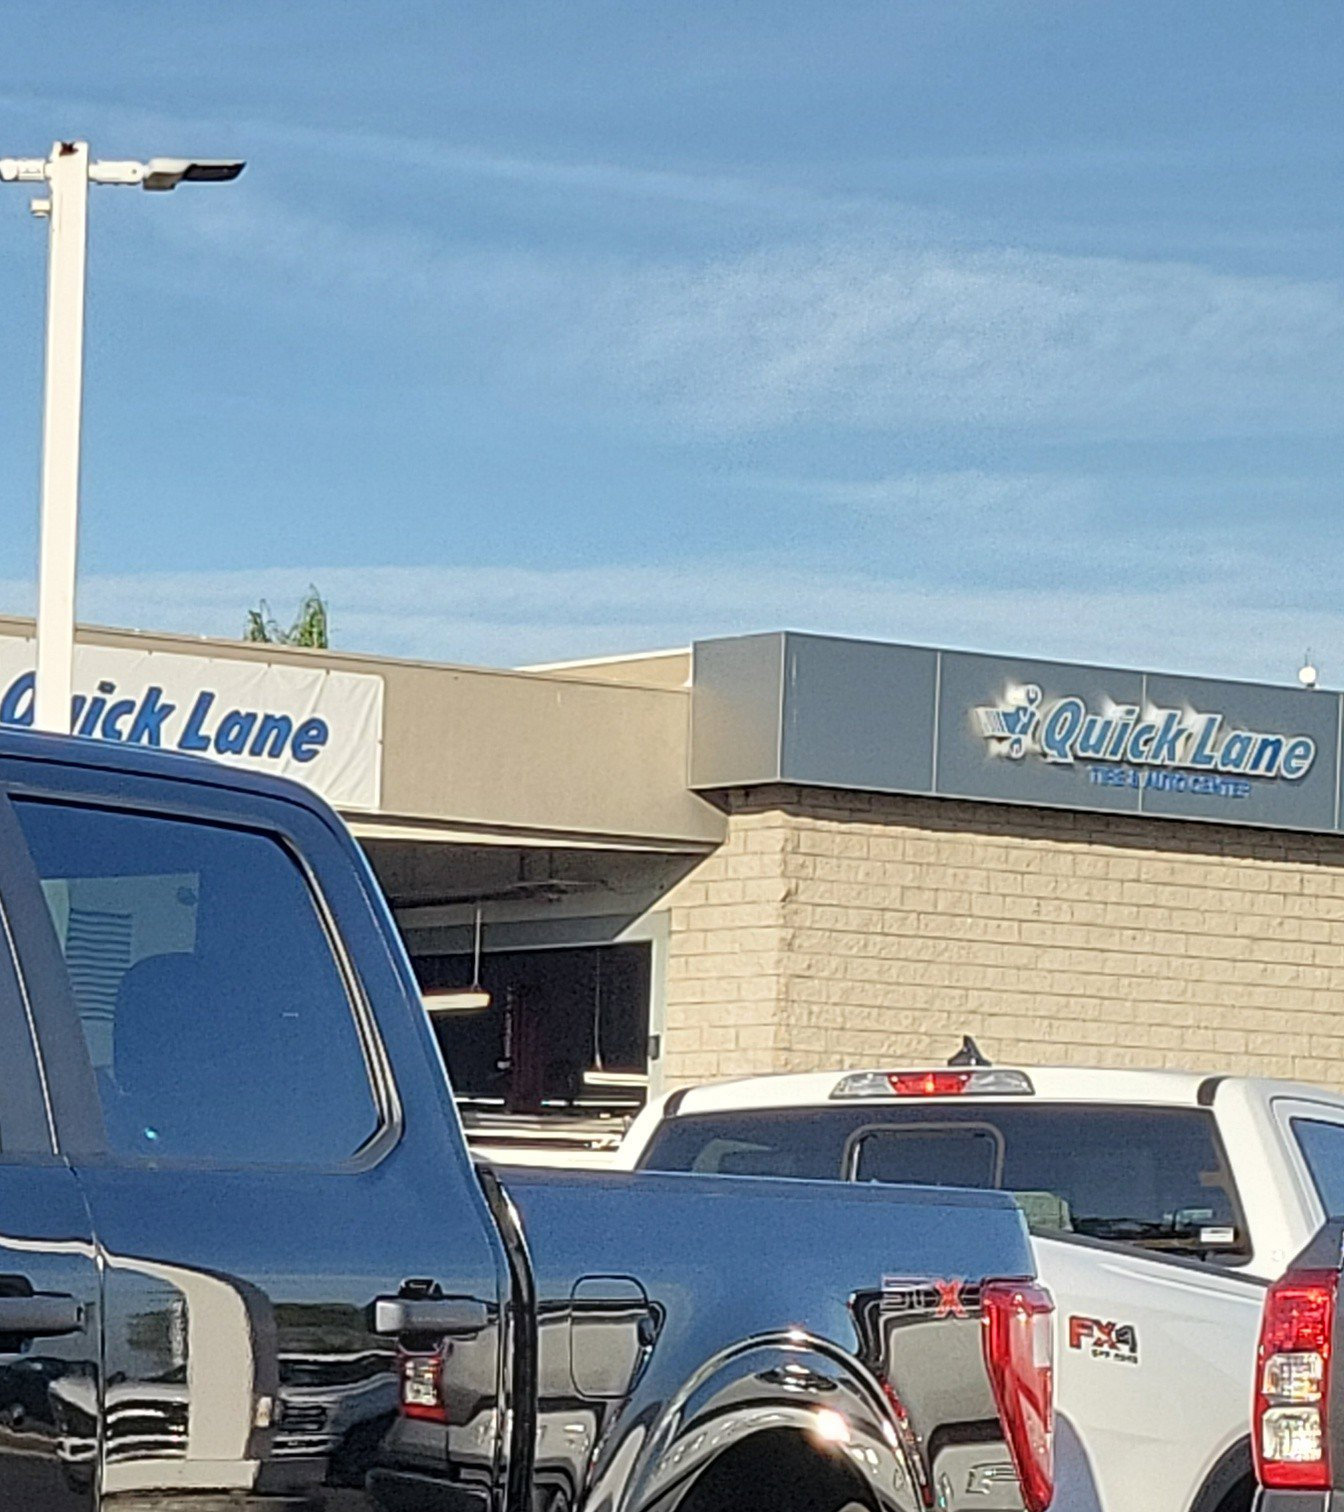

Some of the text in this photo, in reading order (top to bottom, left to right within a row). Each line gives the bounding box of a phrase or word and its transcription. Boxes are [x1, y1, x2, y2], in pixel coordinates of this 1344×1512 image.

[179, 689, 330, 764] Lane
[1041, 696, 1315, 780] Quick Lane
[1068, 1315, 1138, 1354] FX4
